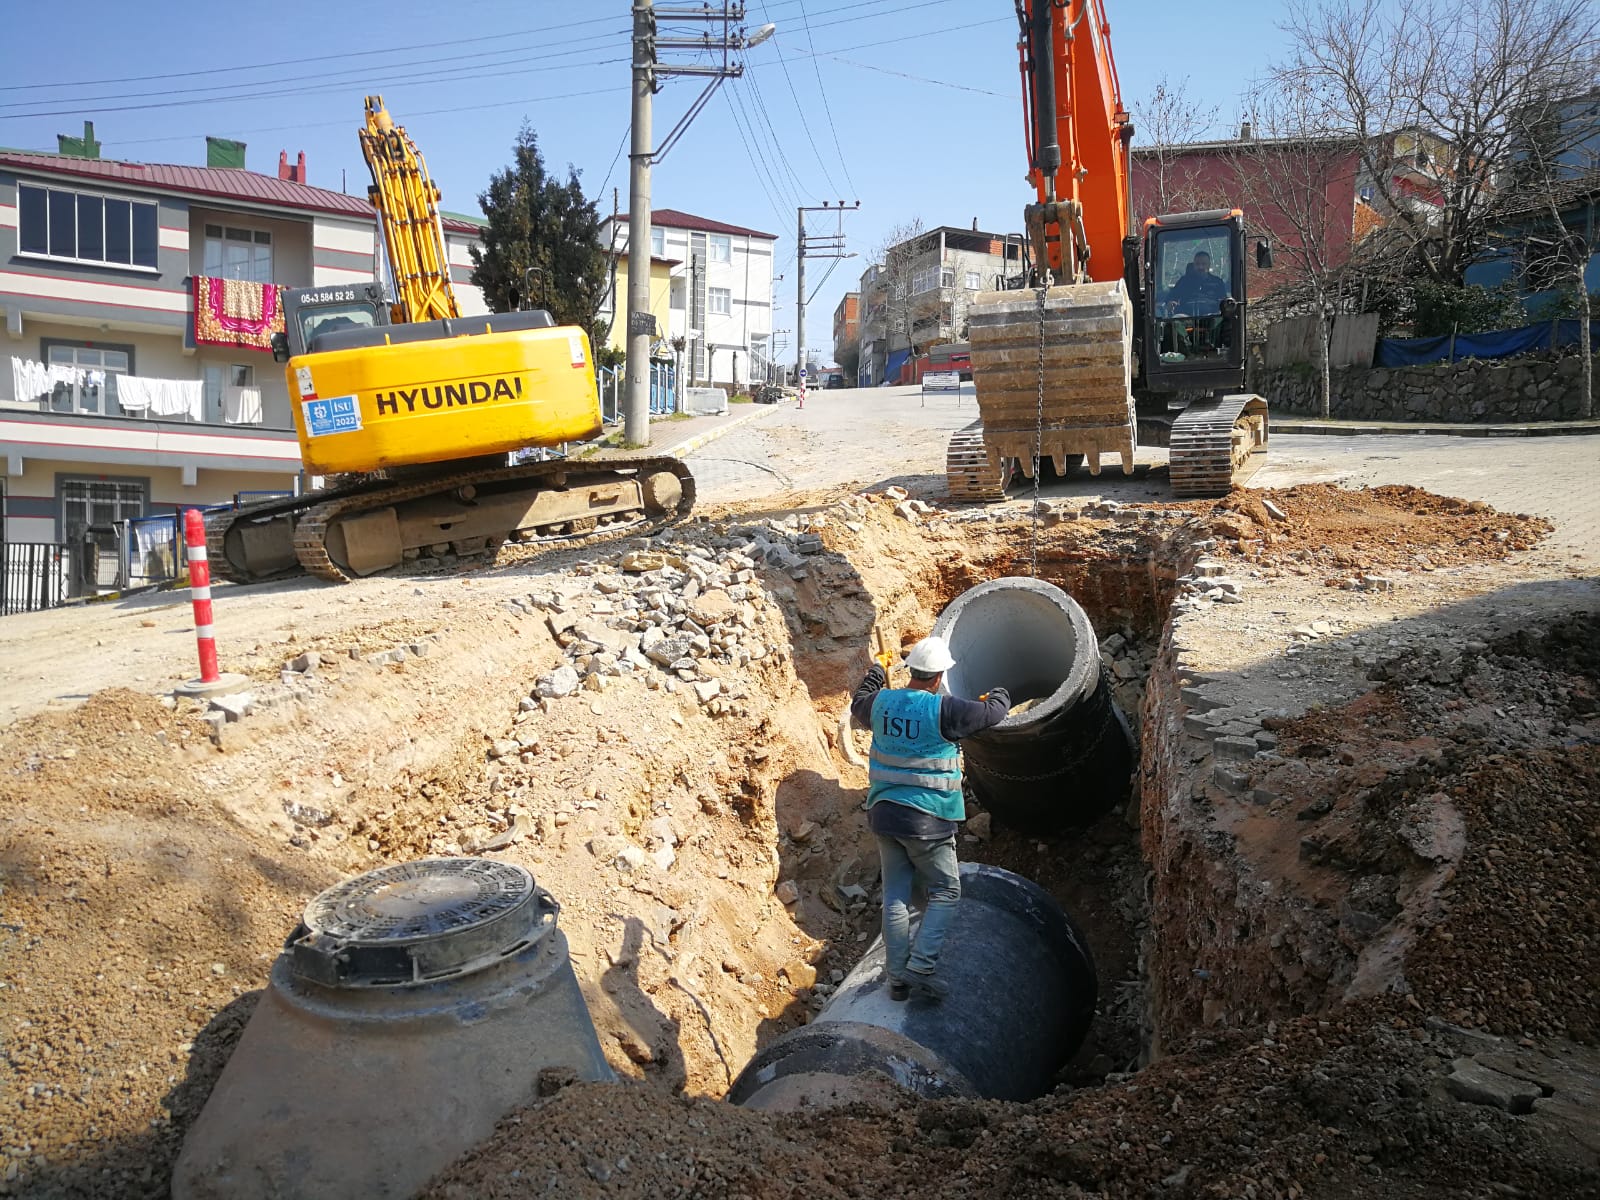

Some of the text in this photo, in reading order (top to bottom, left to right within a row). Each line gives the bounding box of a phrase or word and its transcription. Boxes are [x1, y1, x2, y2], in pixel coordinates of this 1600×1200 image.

[320, 292, 333, 302] 584
[335, 291, 344, 301] 52
[376, 377, 522, 416] HYUNDAI
[335, 416, 355, 427] 2022
[882, 710, 921, 740] İSU
